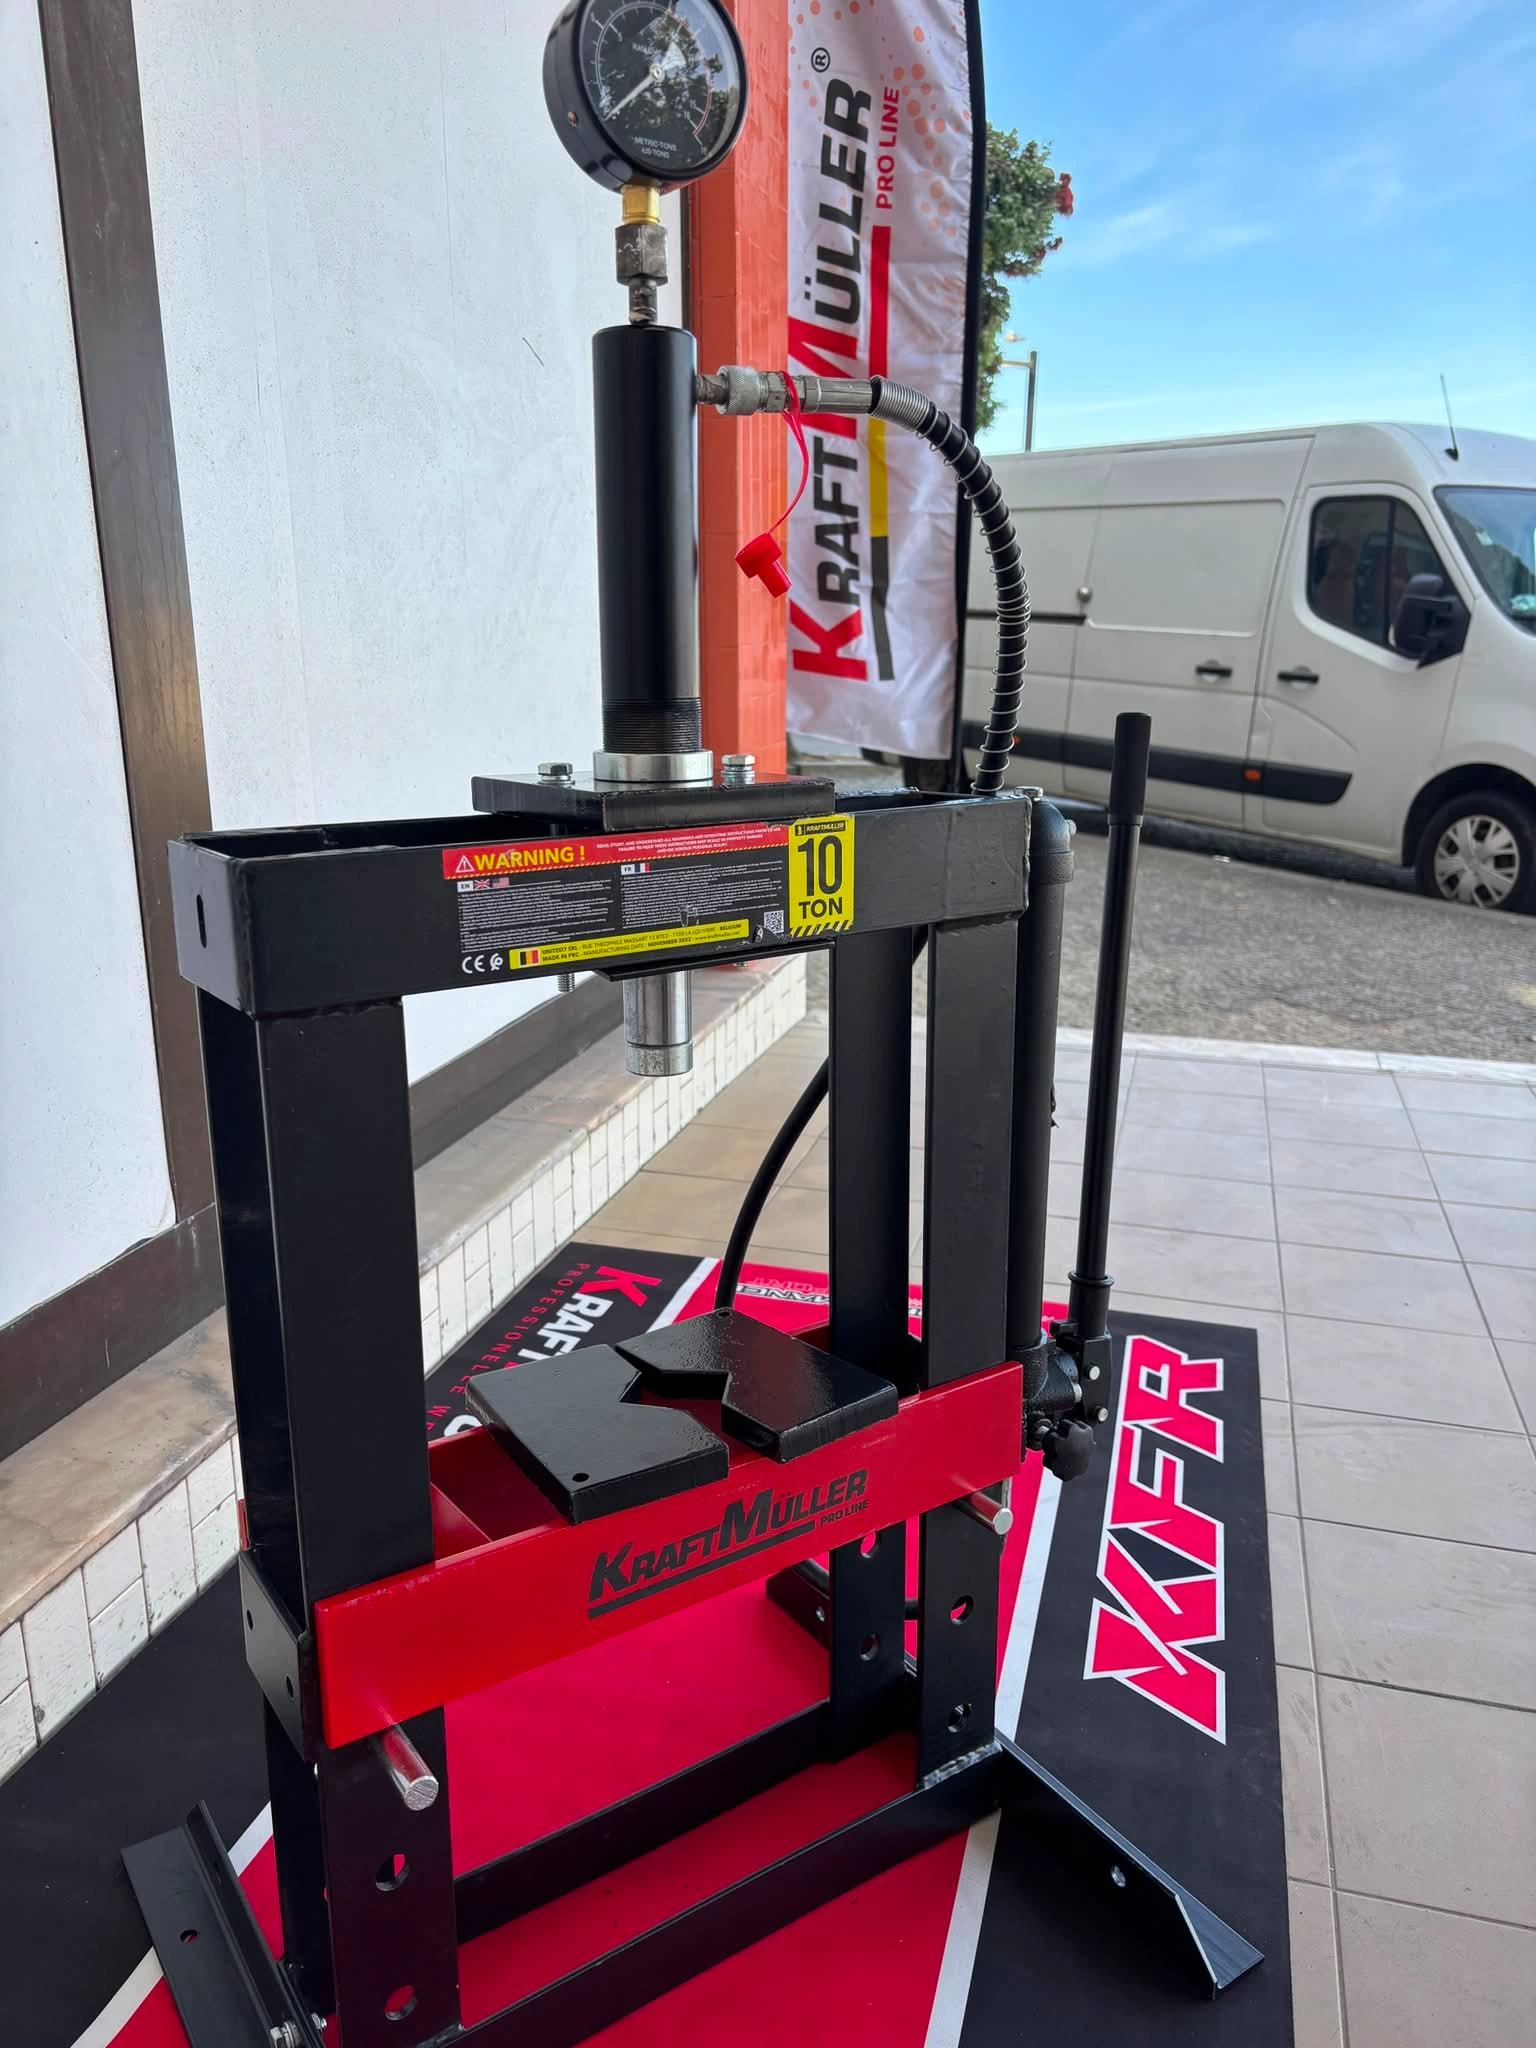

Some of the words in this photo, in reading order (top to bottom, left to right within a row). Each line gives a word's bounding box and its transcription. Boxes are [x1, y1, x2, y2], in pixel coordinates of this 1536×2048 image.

[879, 86, 899, 151] LINE
[876, 155, 894, 210] PRO
[474, 847, 574, 871] WARNING
[798, 835, 843, 896] 10
[798, 897, 843, 919] TON
[588, 1469, 869, 1601] KRAFTMÜLLER
[820, 1510, 843, 1527] PRO
[845, 1500, 869, 1518] LINE
